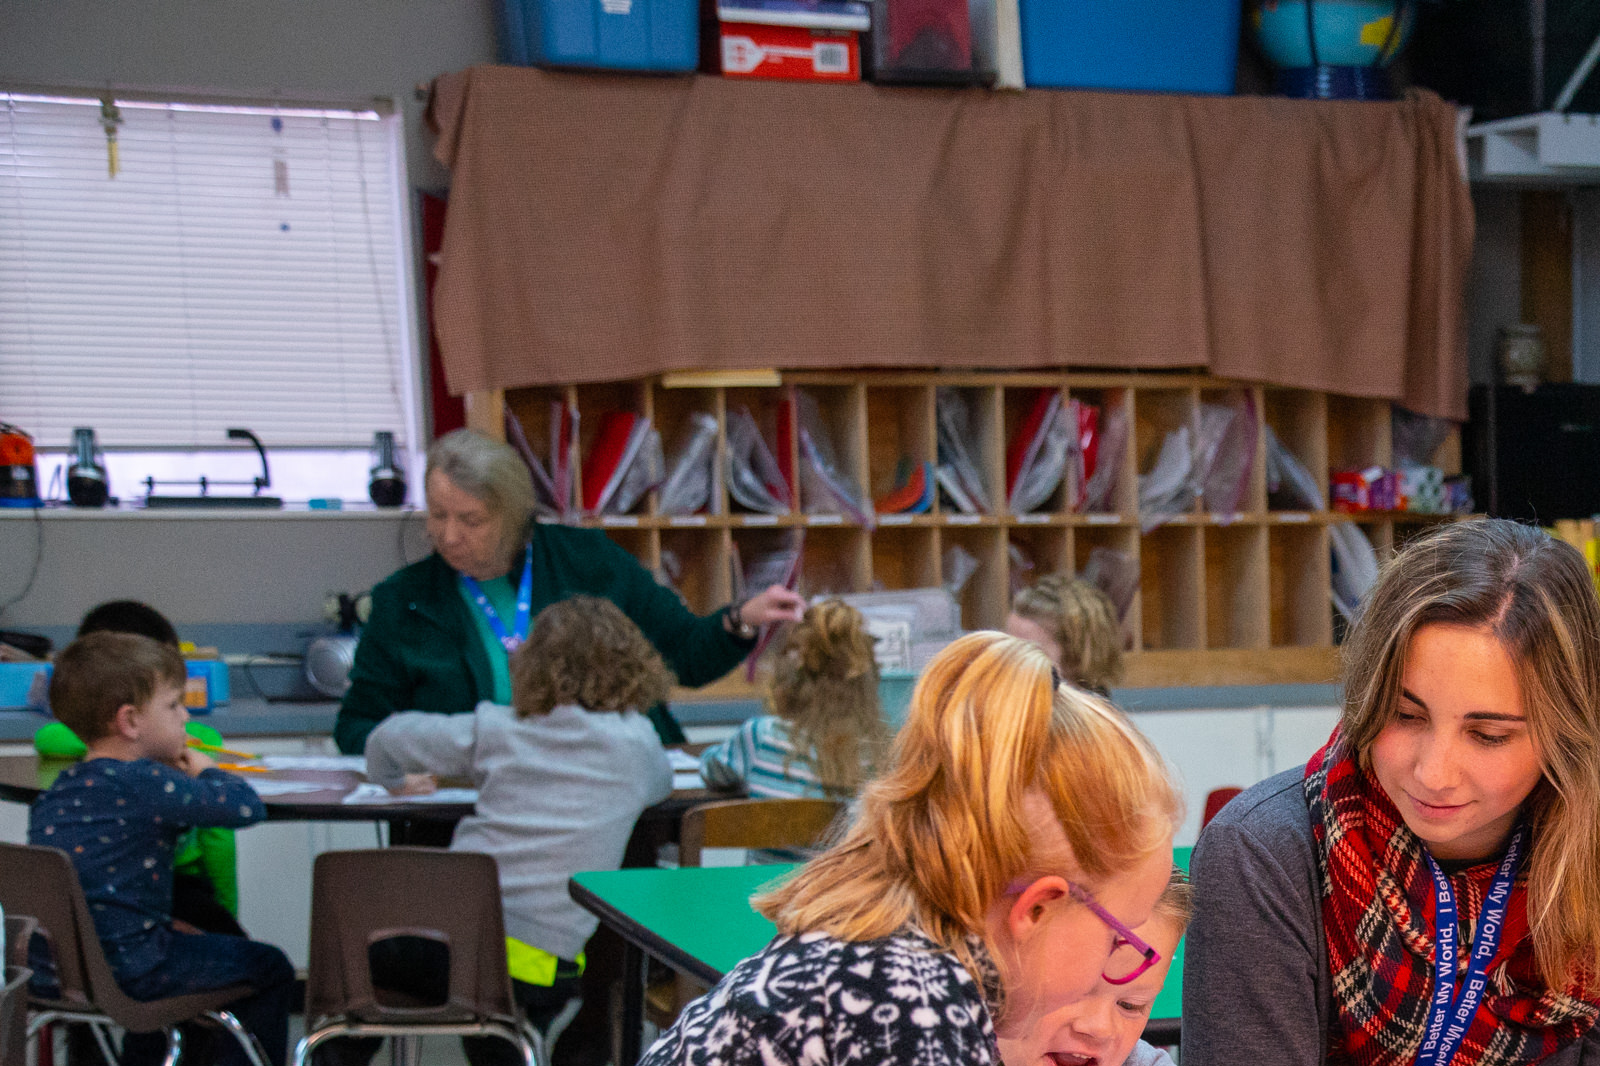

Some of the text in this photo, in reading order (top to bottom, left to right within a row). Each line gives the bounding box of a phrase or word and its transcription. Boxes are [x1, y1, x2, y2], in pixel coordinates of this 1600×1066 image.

[1488, 881, 1510, 904] My
[1438, 922, 1455, 978] World,
[1474, 908, 1504, 960] World,
[1435, 981, 1453, 1005] My
[1455, 979, 1485, 1024] Better
[1423, 1008, 1447, 1051] Better
